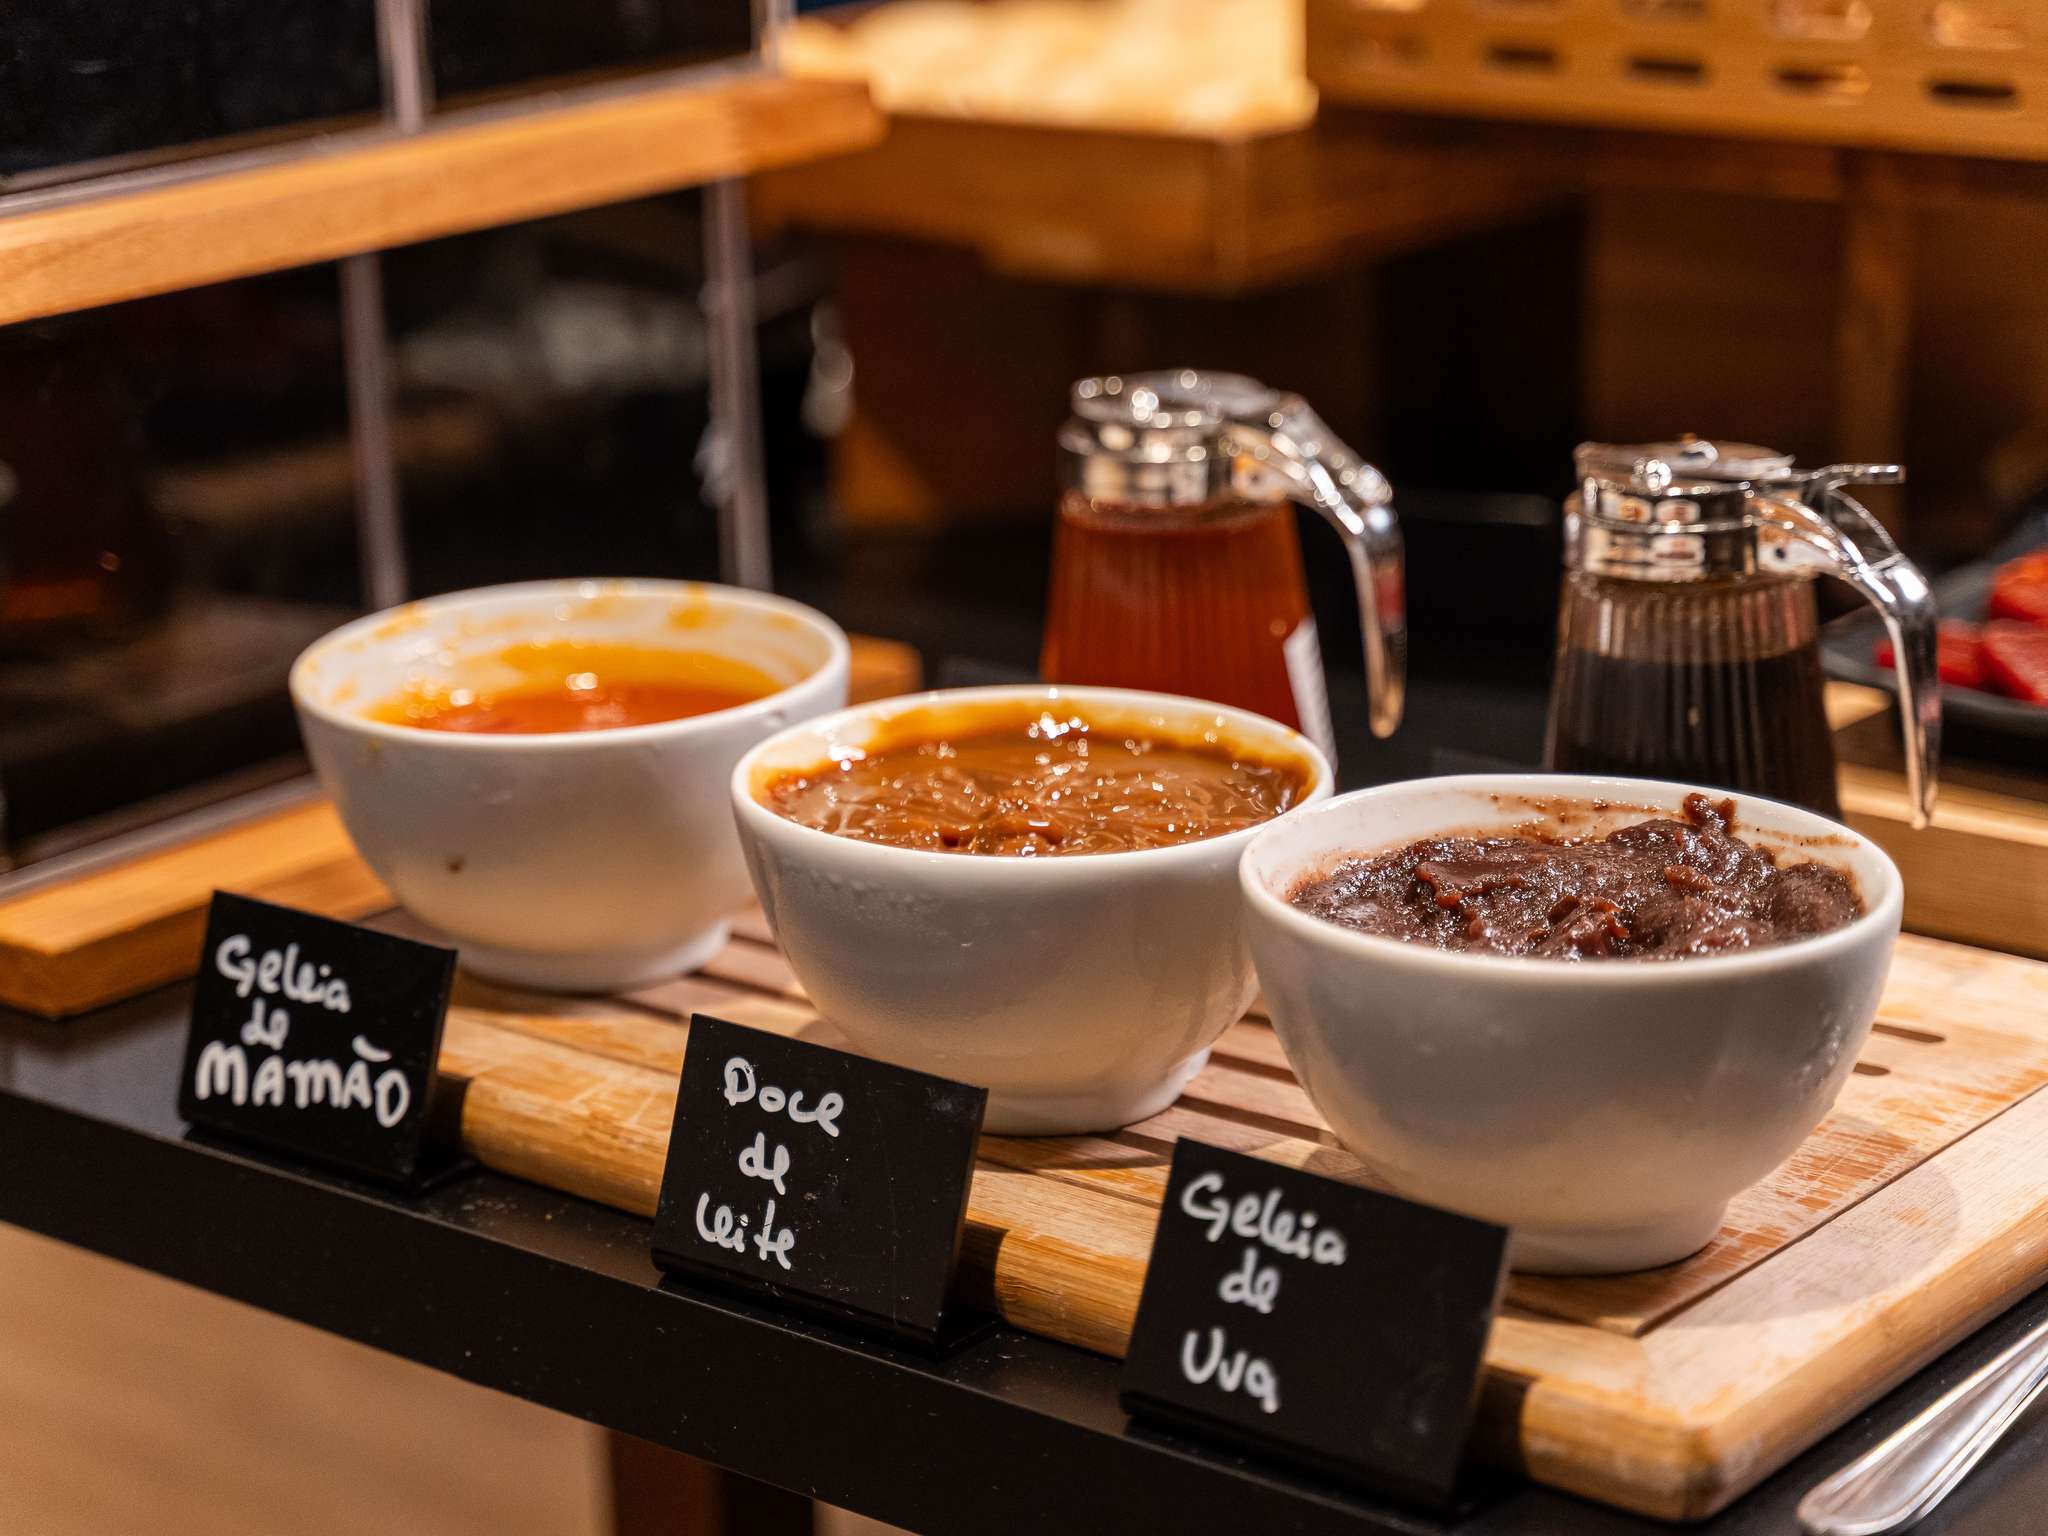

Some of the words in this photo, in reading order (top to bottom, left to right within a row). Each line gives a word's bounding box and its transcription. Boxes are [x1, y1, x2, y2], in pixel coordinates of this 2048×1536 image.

[215, 934, 351, 1014] Geleia
[240, 998, 290, 1051] de
[723, 1056, 845, 1138] Doce
[738, 1131, 790, 1196] de
[1180, 1171, 1347, 1266] Geleia
[1218, 1246, 1280, 1315] de
[1180, 1326, 1280, 1414] Uva
